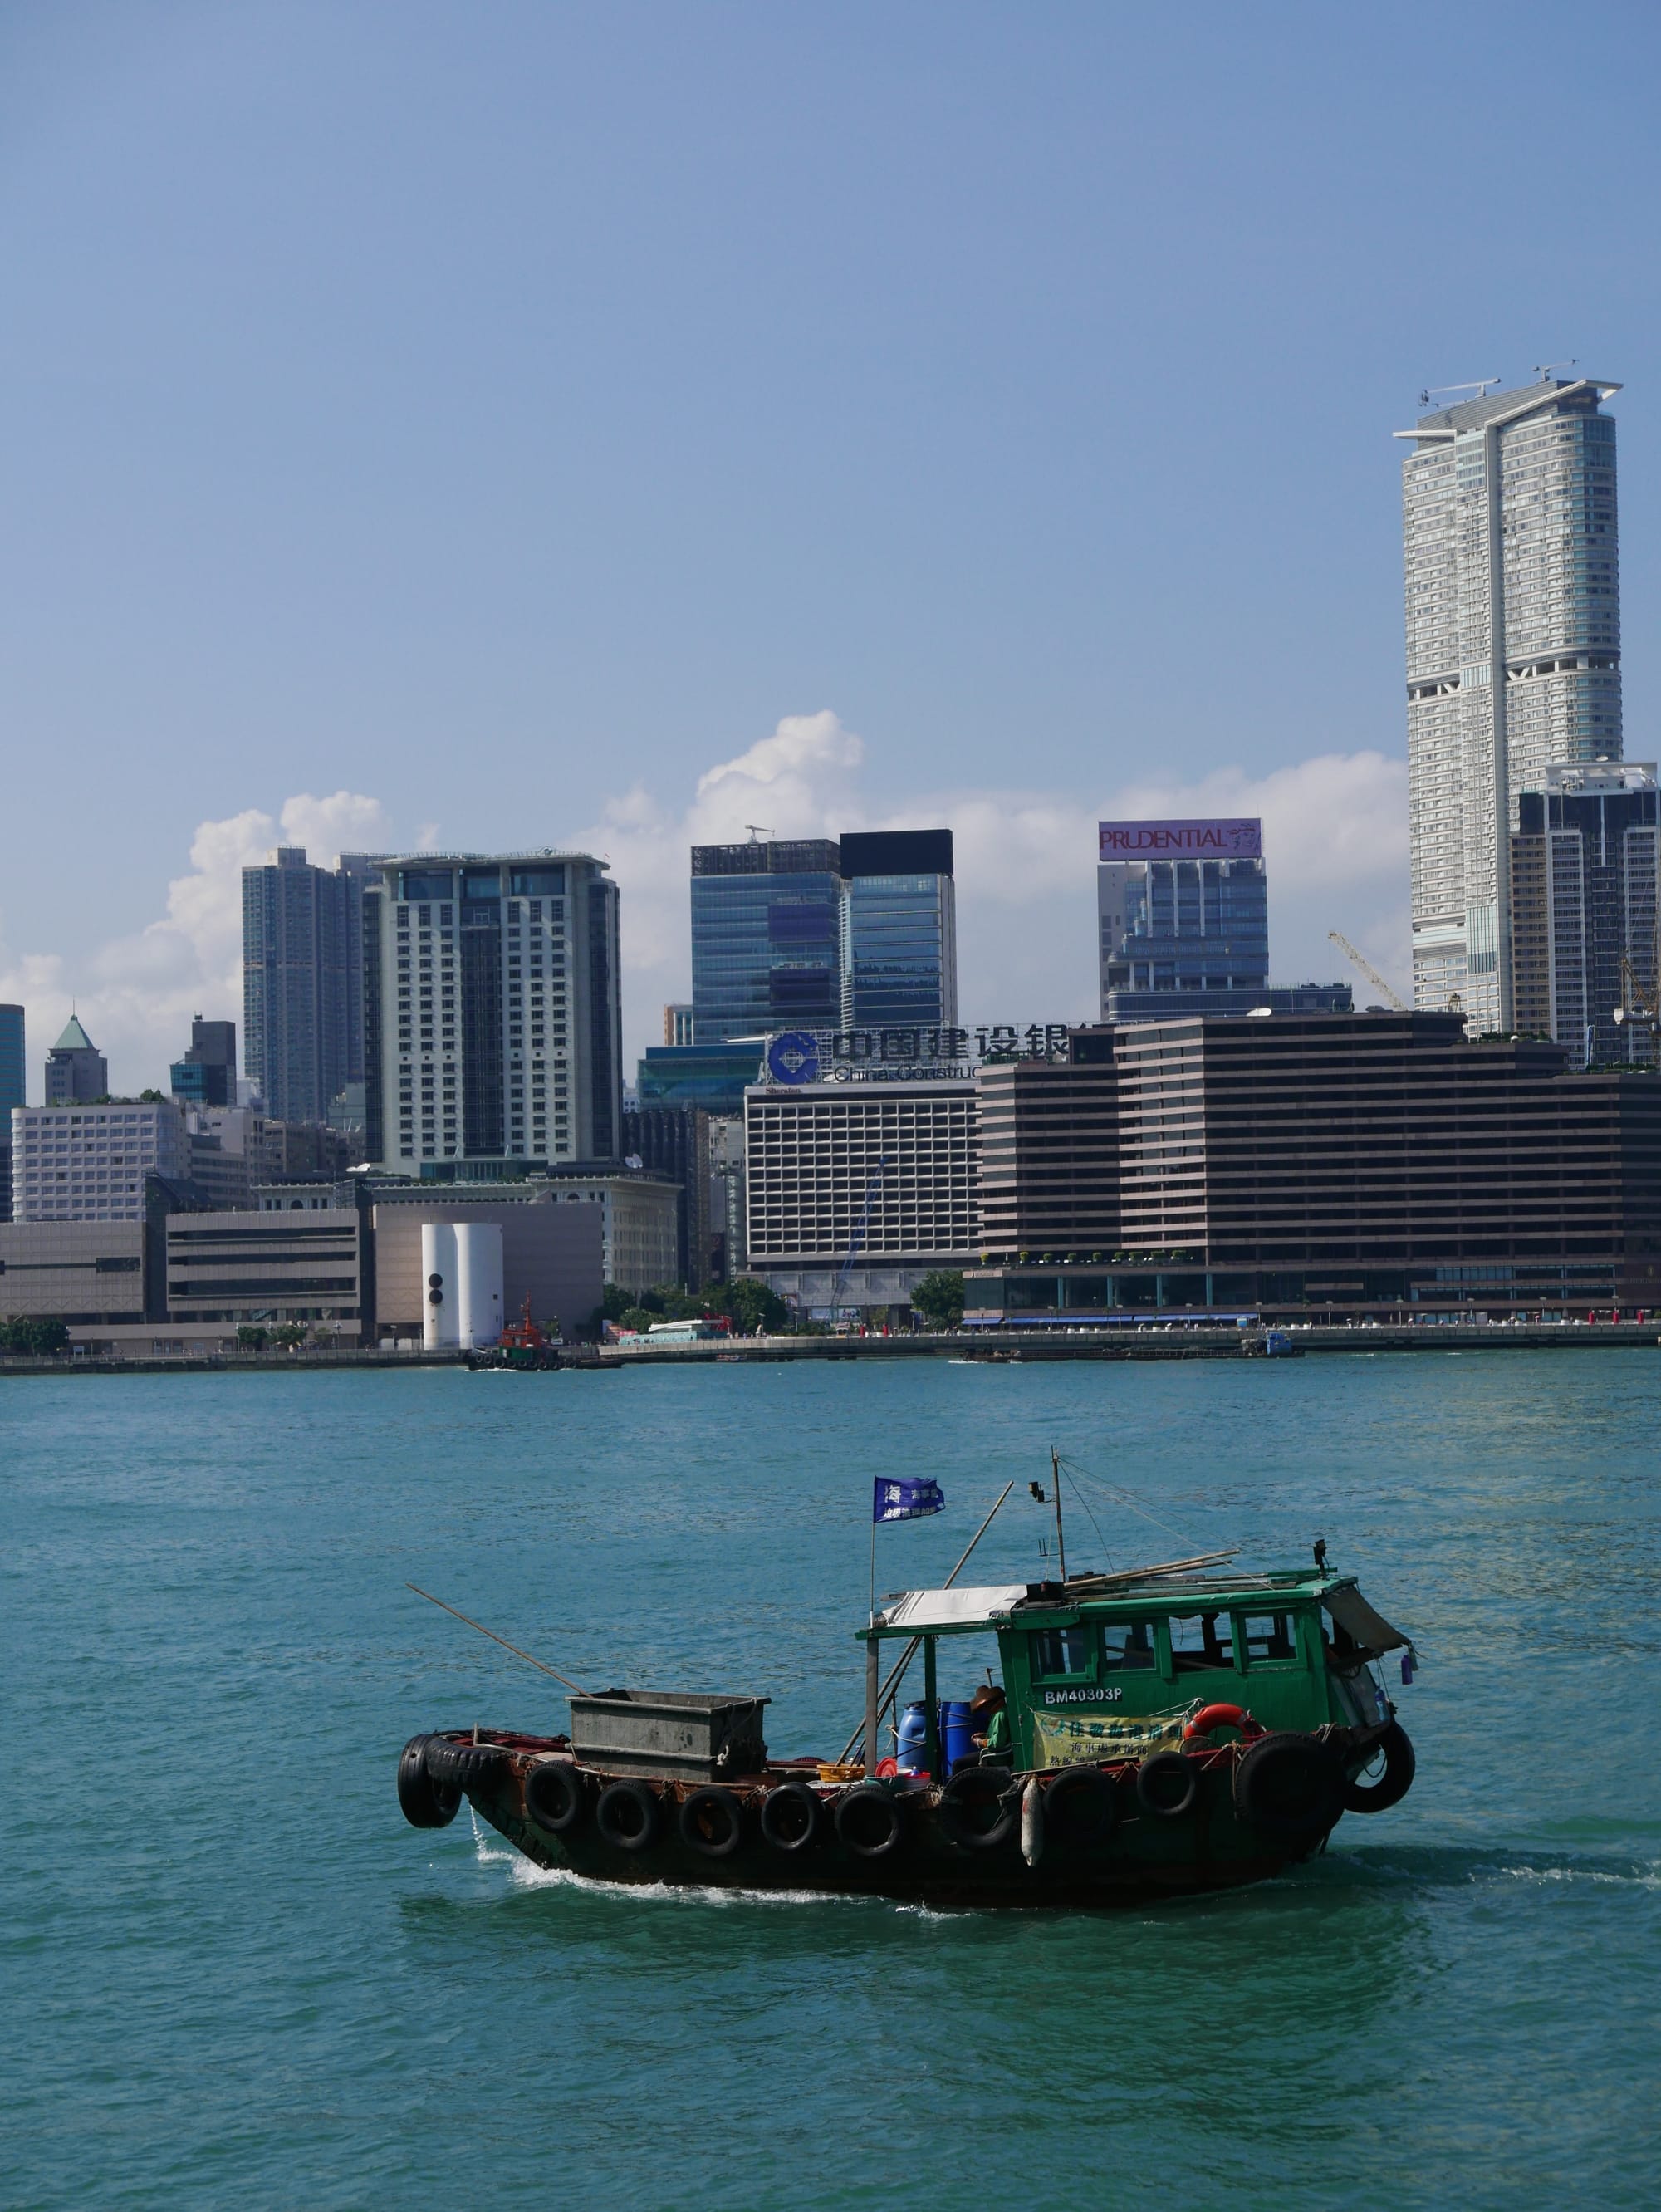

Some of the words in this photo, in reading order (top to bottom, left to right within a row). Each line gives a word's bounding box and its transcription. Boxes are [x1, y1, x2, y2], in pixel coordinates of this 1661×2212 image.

[1099, 829, 1228, 850] PRUDENTIAL
[833, 1023, 1116, 1061] 中国建设银
[834, 1066, 889, 1083] China
[1045, 1687, 1122, 1704] BM40303P
